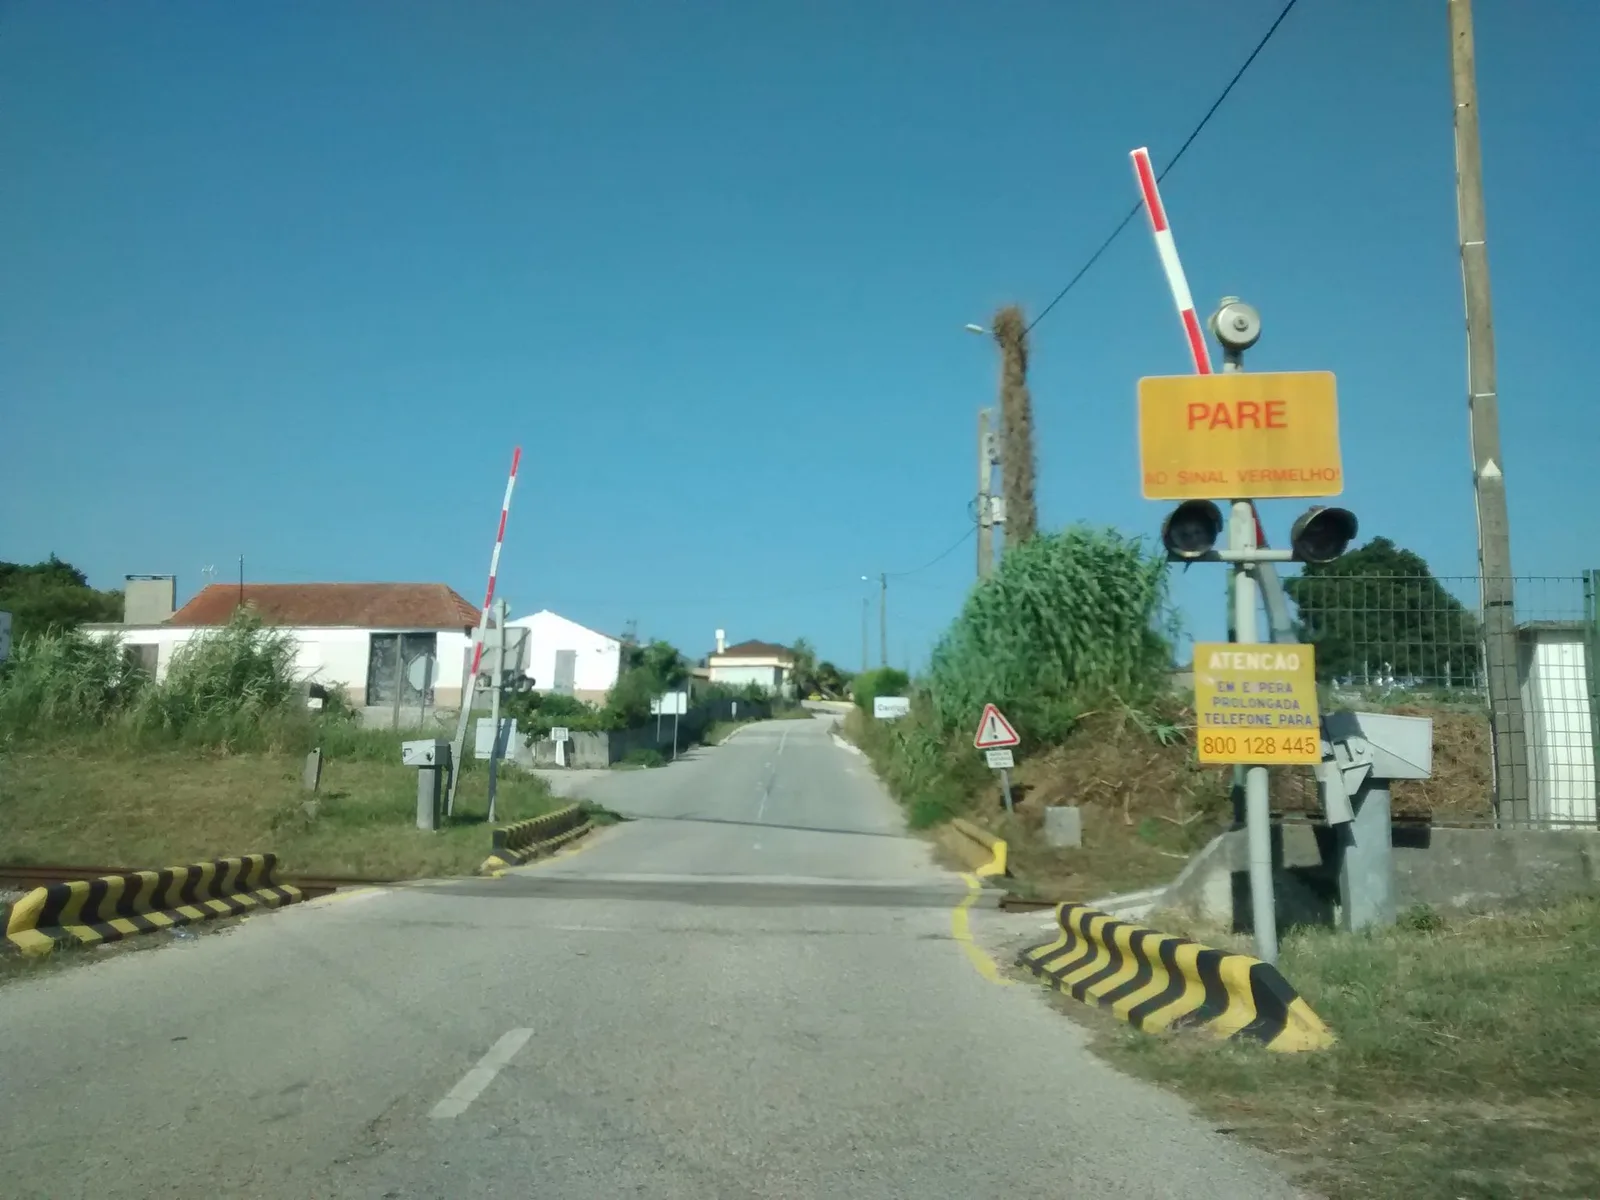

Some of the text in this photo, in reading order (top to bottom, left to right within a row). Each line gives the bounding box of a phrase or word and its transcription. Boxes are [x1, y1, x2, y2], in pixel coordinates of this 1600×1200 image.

[1186, 400, 1288, 430] PARE
[1178, 469, 1228, 485] SINAL
[1217, 681, 1236, 693] EM
[1212, 696, 1301, 710] PROLONGADA
[1204, 713, 1313, 725] TELEFONE PARA
[1203, 736, 1316, 755] 800 128 445
